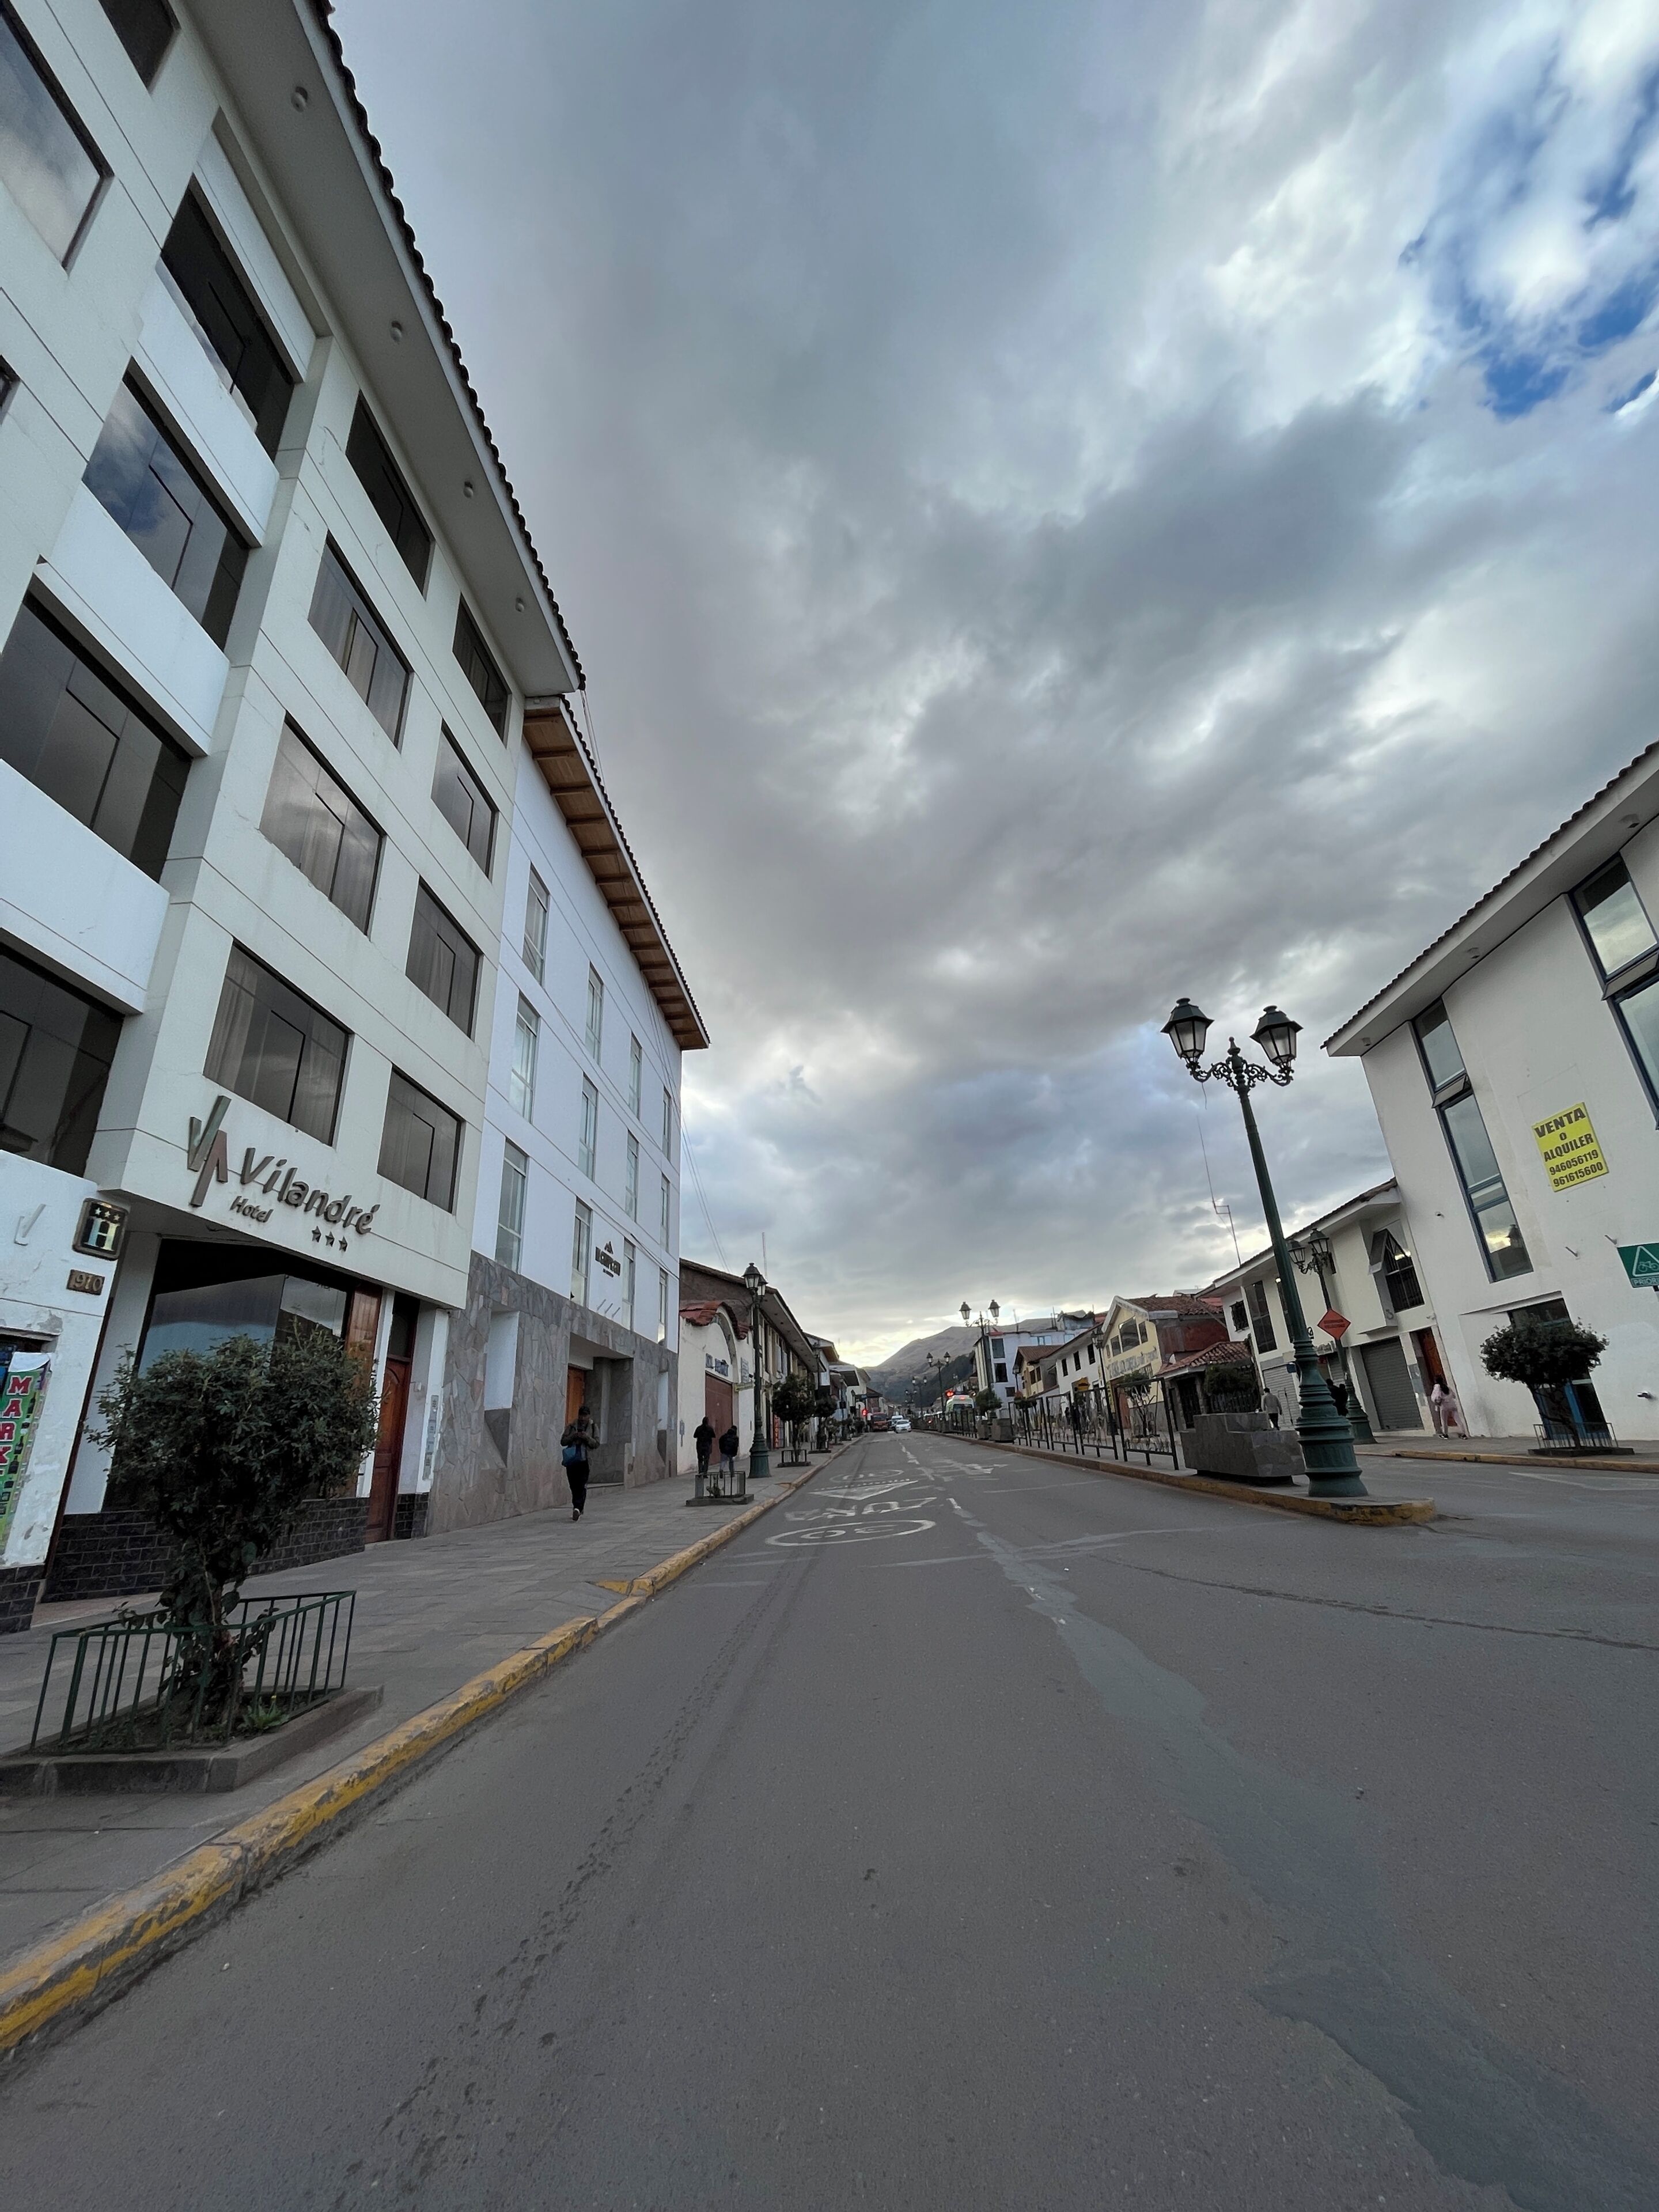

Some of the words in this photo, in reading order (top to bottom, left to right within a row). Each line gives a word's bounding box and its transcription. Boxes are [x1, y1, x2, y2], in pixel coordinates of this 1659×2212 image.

[1534, 1107, 1586, 1138] VENTA
[1544, 1133, 1594, 1162] ALQUILER
[1549, 1149, 1599, 1175] 946056119
[1553, 1162, 1603, 1187] 961615600
[240, 1147, 381, 1234] Vilandré
[230, 1195, 274, 1222] Hotel
